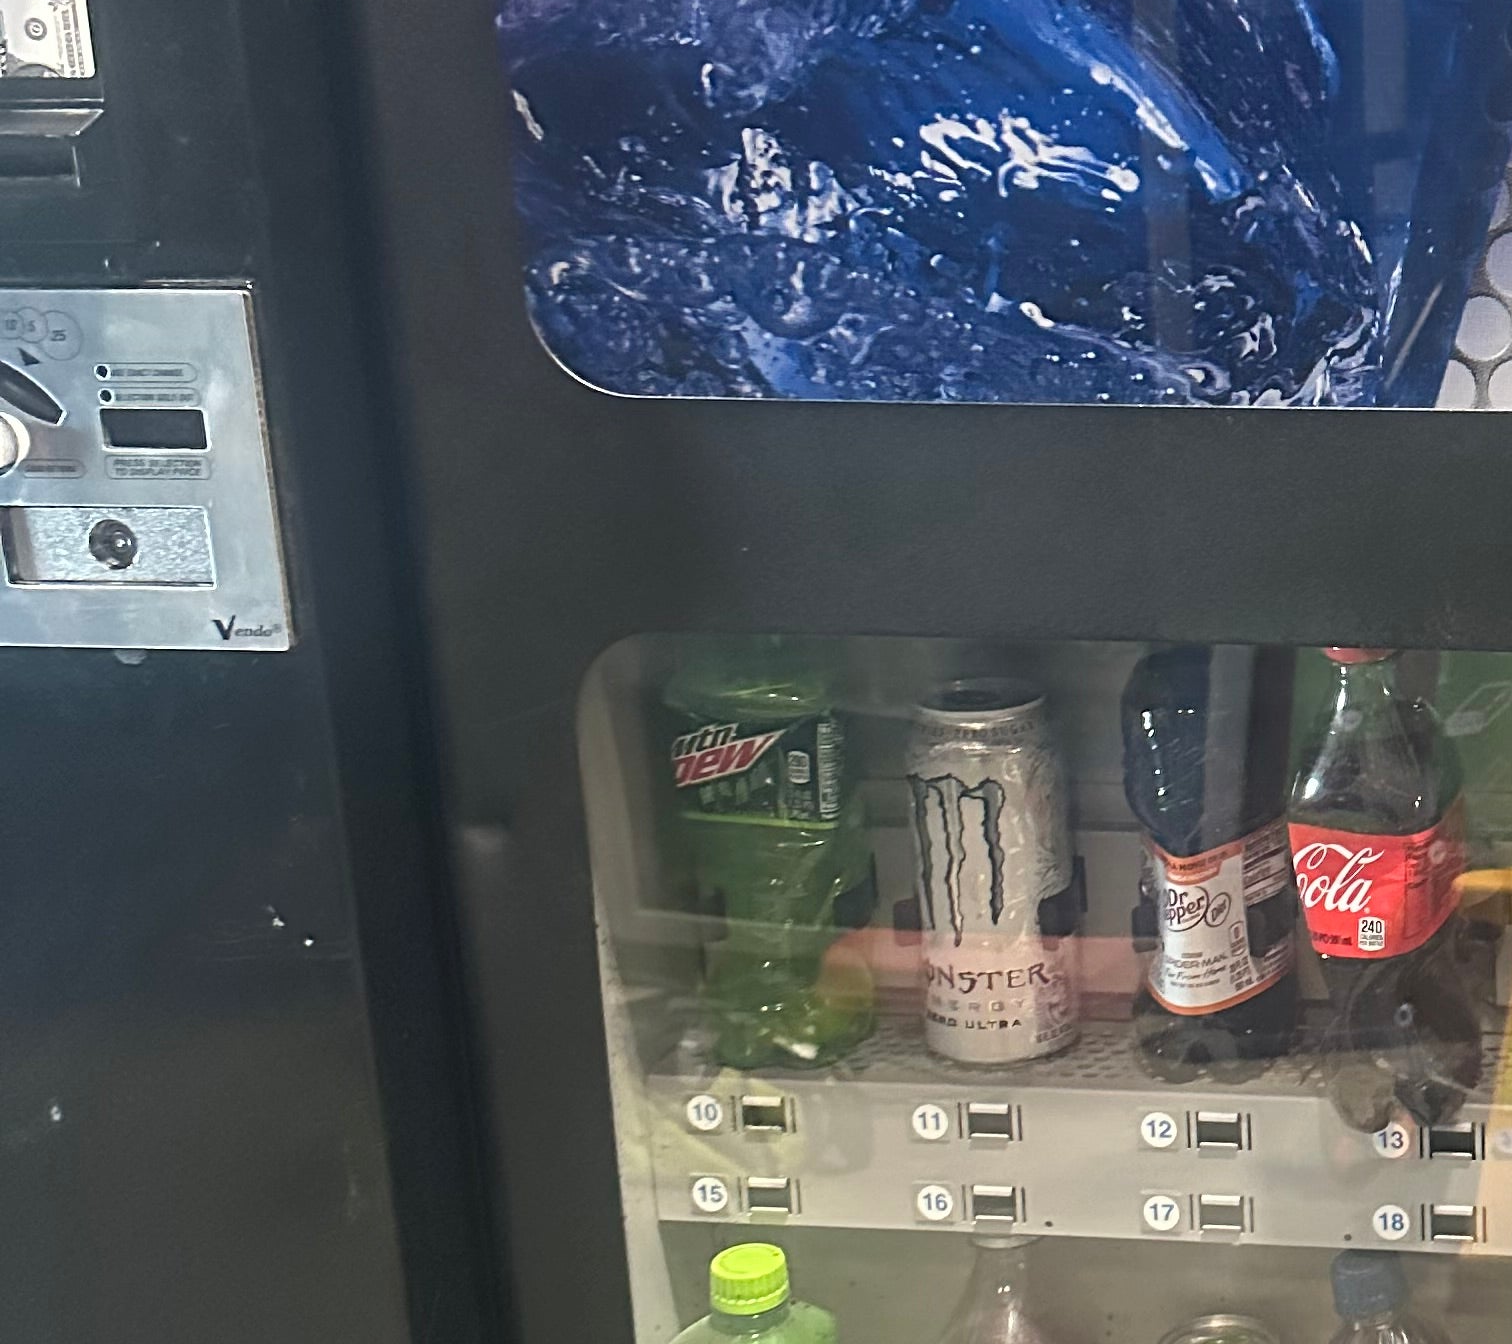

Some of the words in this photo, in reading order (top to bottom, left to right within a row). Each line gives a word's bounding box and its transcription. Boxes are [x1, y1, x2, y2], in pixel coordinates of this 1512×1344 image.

[1167, 888, 1188, 907] Dr
[1166, 894, 1205, 926] pper
[1361, 919, 1383, 934] 240
[926, 958, 1050, 994] ONSTER
[931, 994, 1026, 1013] NERGY
[965, 1019, 1022, 1031] ULTRA
[693, 1102, 718, 1122] 10
[918, 1112, 943, 1131] 11
[1147, 1120, 1172, 1139] 12
[1379, 1131, 1404, 1150] 13
[698, 1184, 724, 1203] 15
[922, 1193, 948, 1212] 16
[1149, 1203, 1174, 1222] 17
[1379, 1213, 1404, 1232] 18
